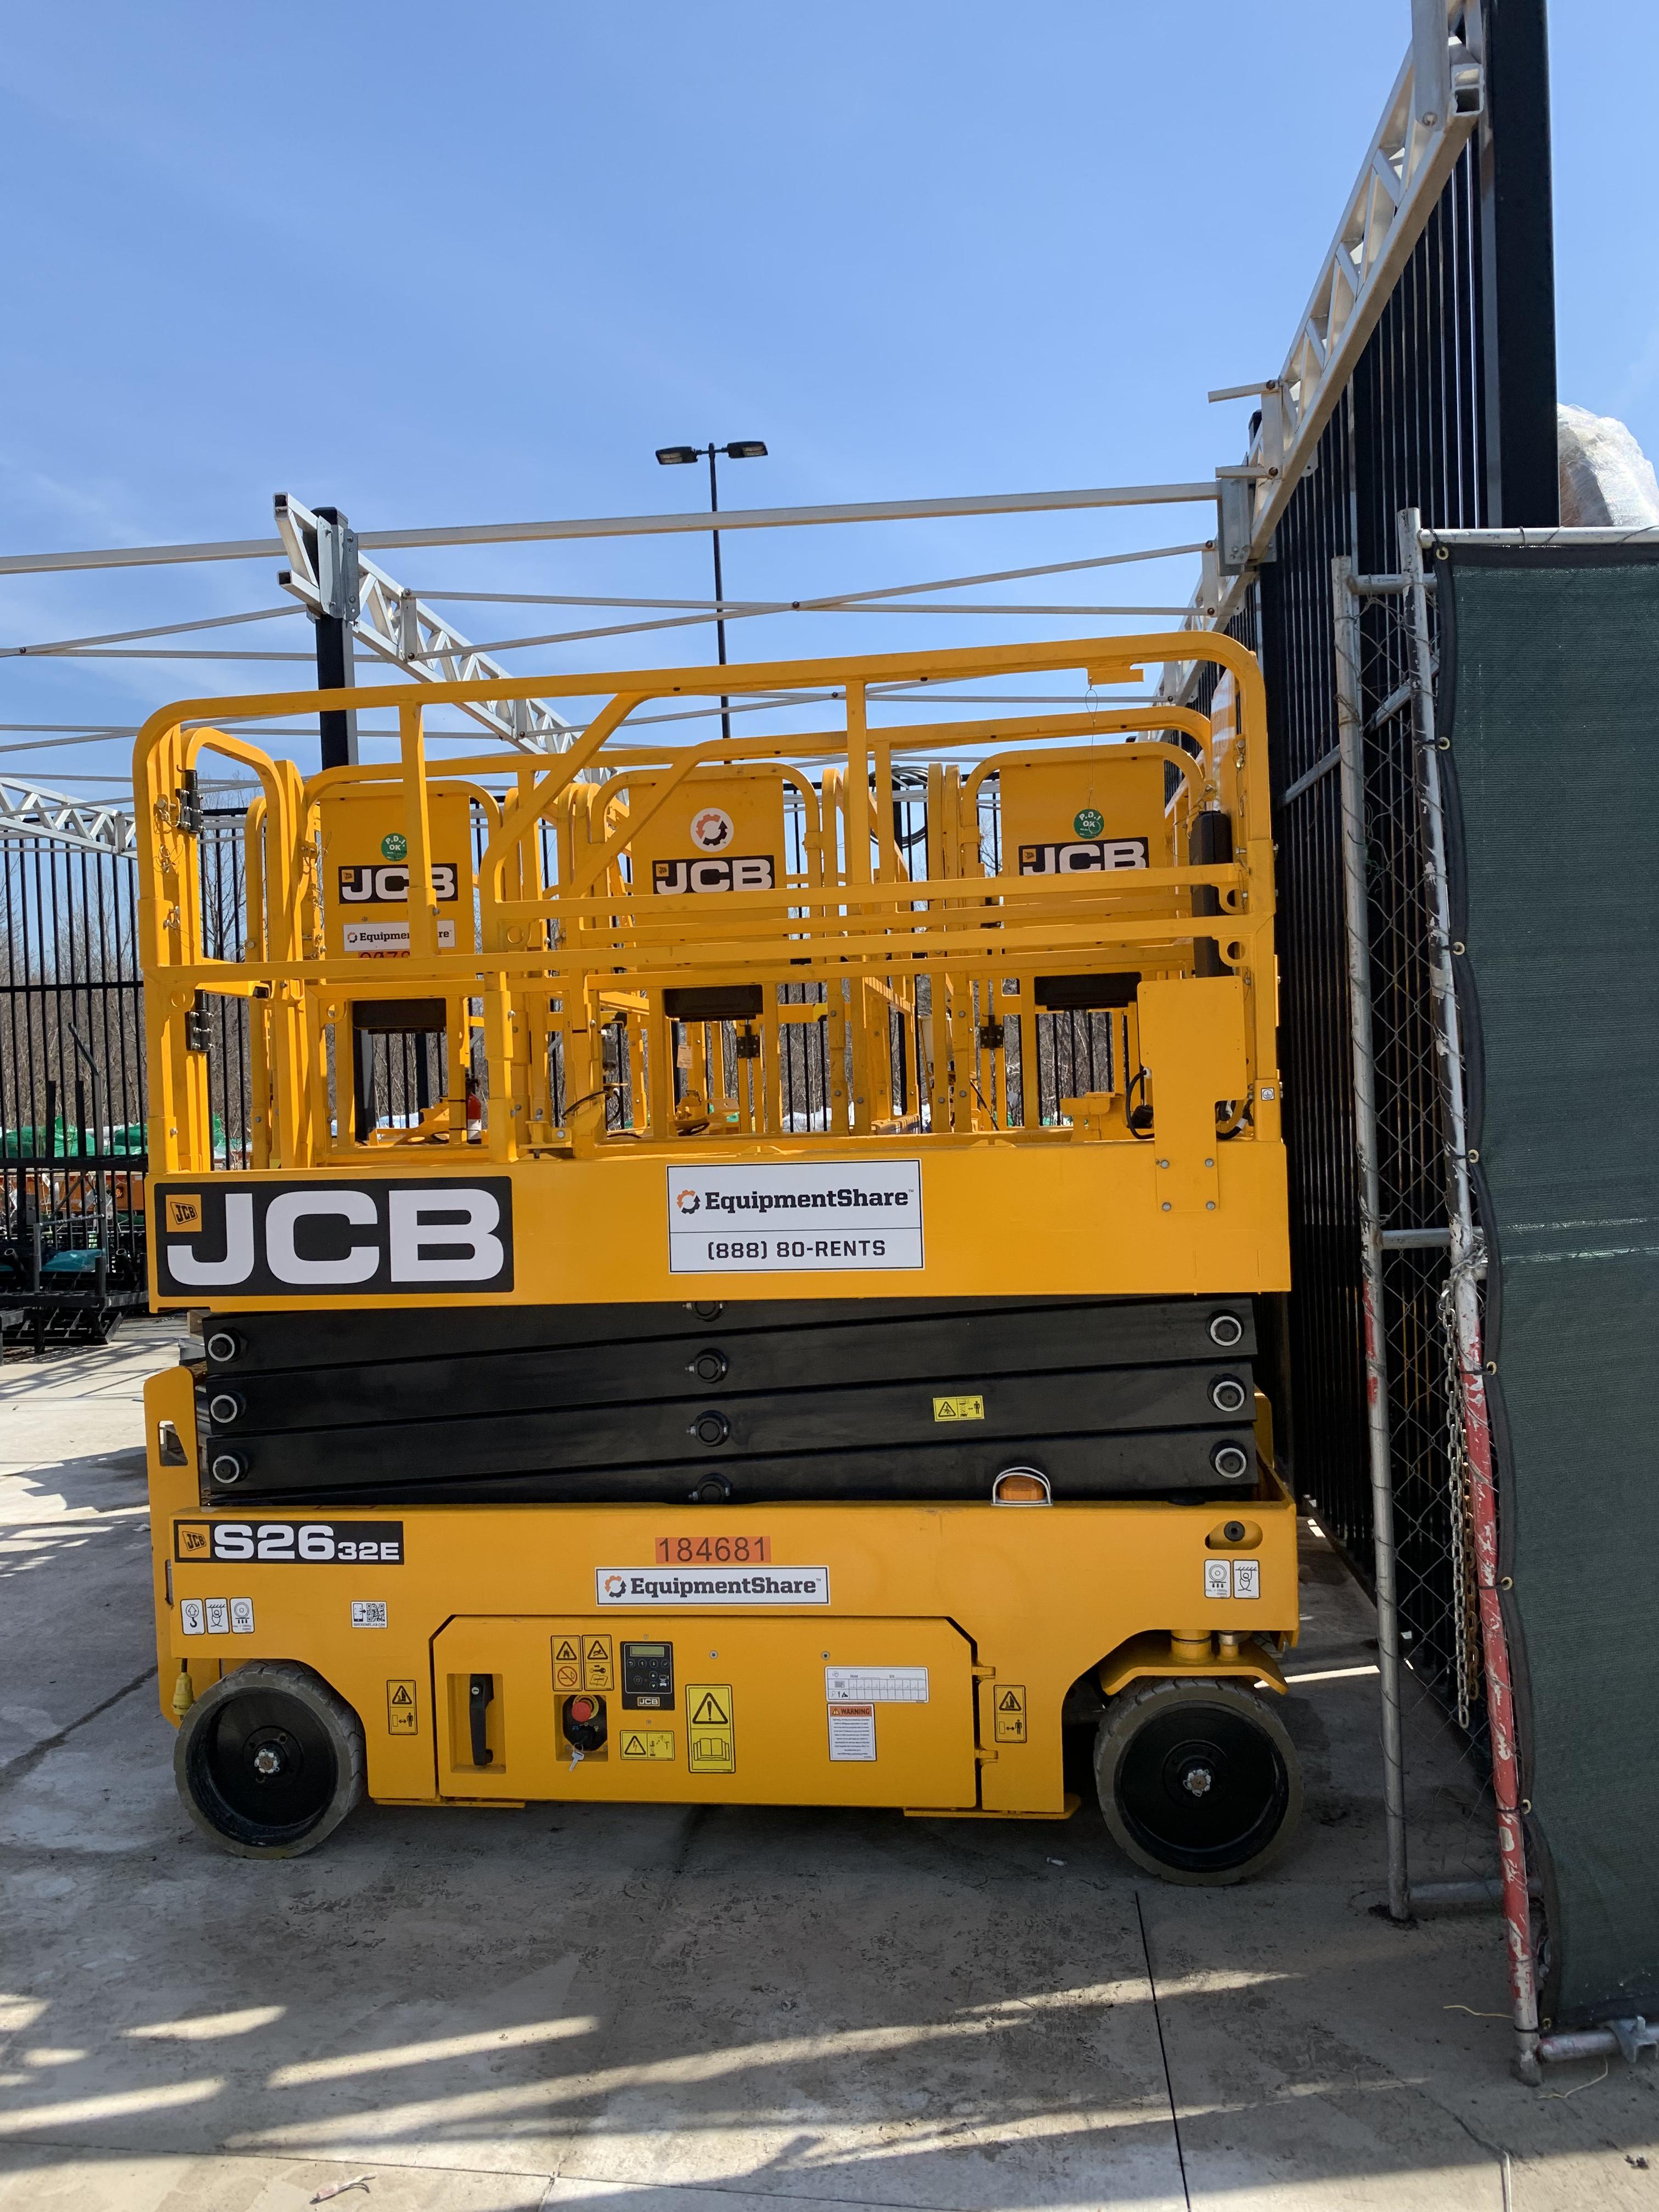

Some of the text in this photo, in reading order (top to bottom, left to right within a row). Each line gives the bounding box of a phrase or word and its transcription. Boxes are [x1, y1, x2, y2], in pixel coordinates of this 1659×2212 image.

[1023, 841, 1147, 876] JCB
[342, 867, 455, 901] JCB
[656, 859, 772, 894] JCB
[174, 1204, 196, 1222] JCB
[705, 1188, 909, 1214] EquipmentShare
[167, 1188, 504, 1285] JCB
[708, 1240, 886, 1260] (888) 80-RENTS
[187, 1533, 205, 1549] JCB
[214, 1524, 400, 1560] S26 32E
[658, 1537, 765, 1562] 184681
[630, 1576, 816, 1598] EquipmentShare
